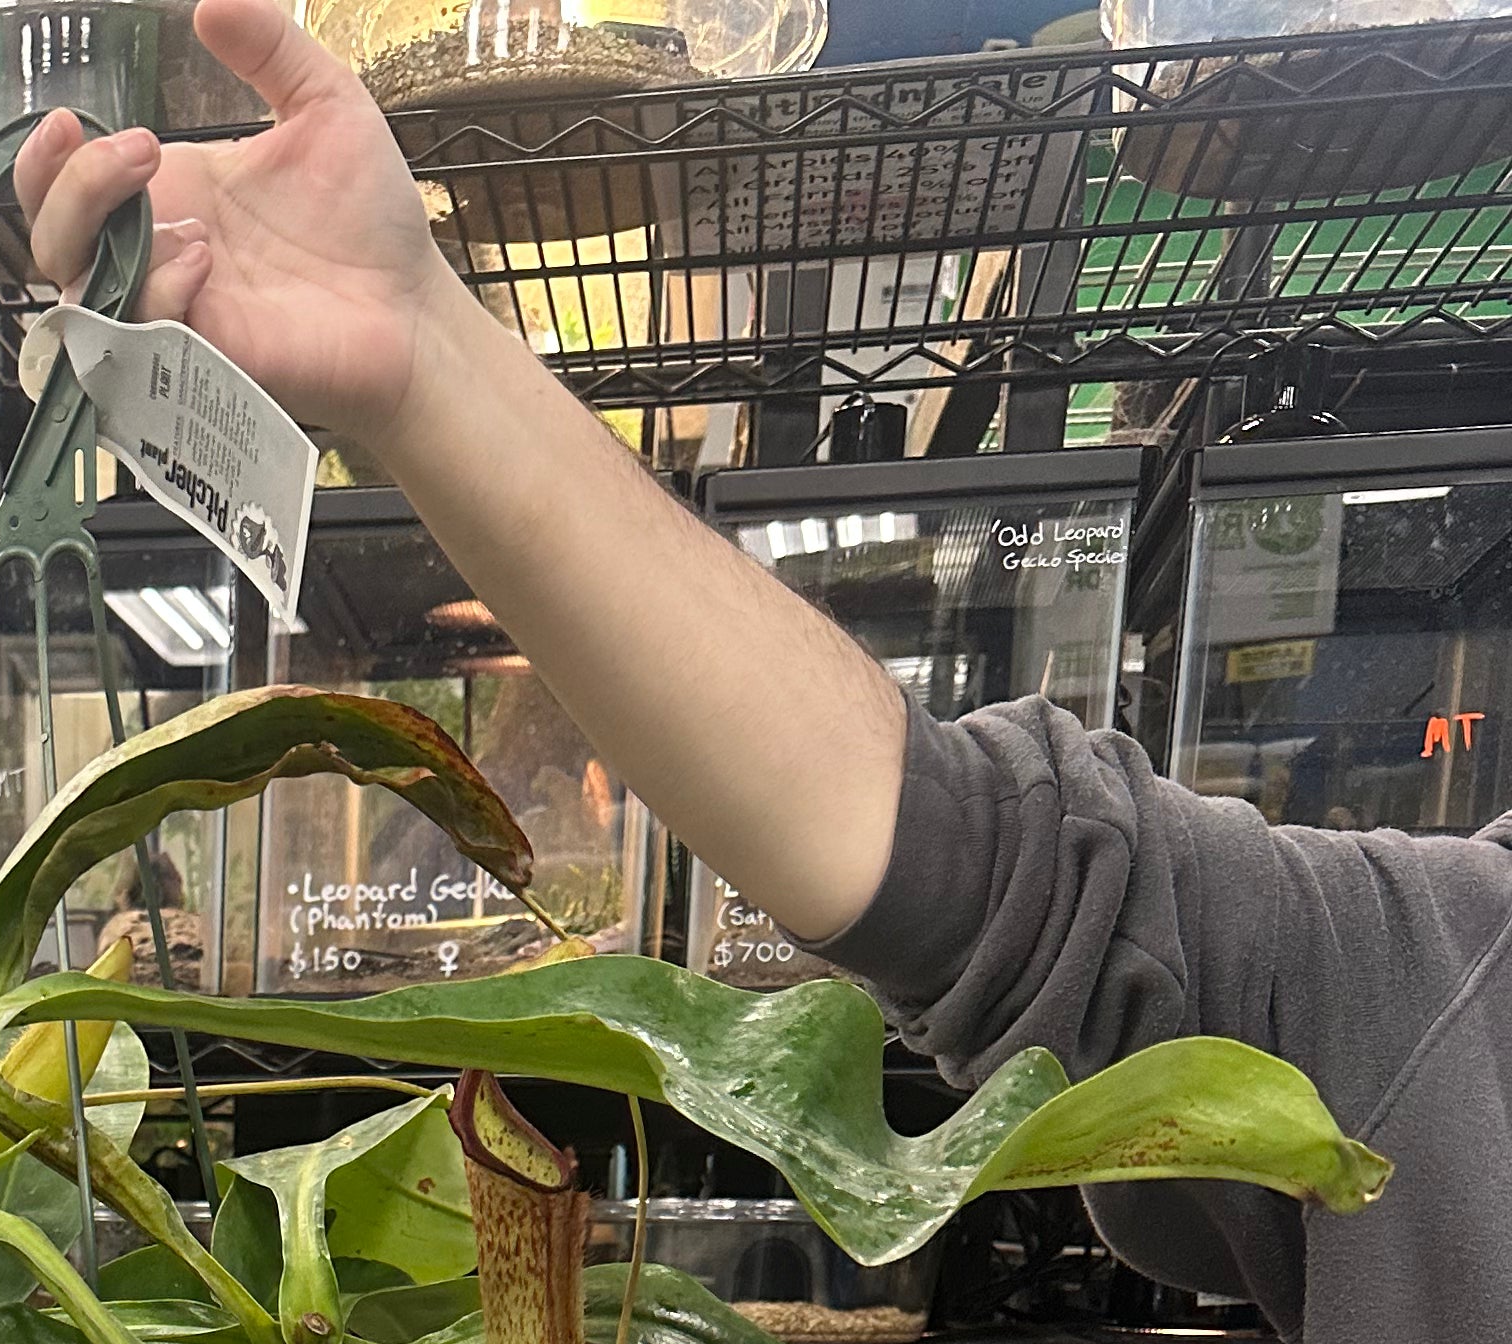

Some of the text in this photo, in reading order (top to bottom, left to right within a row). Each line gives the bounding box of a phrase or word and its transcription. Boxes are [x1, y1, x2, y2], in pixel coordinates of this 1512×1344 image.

[1054, 518, 1125, 546] Leopard
[1002, 551, 1063, 570] Gecko
[303, 867, 418, 911] Leopard
[290, 903, 439, 936] (Phantom)
[289, 942, 363, 980] $150
[713, 938, 796, 968] $700
